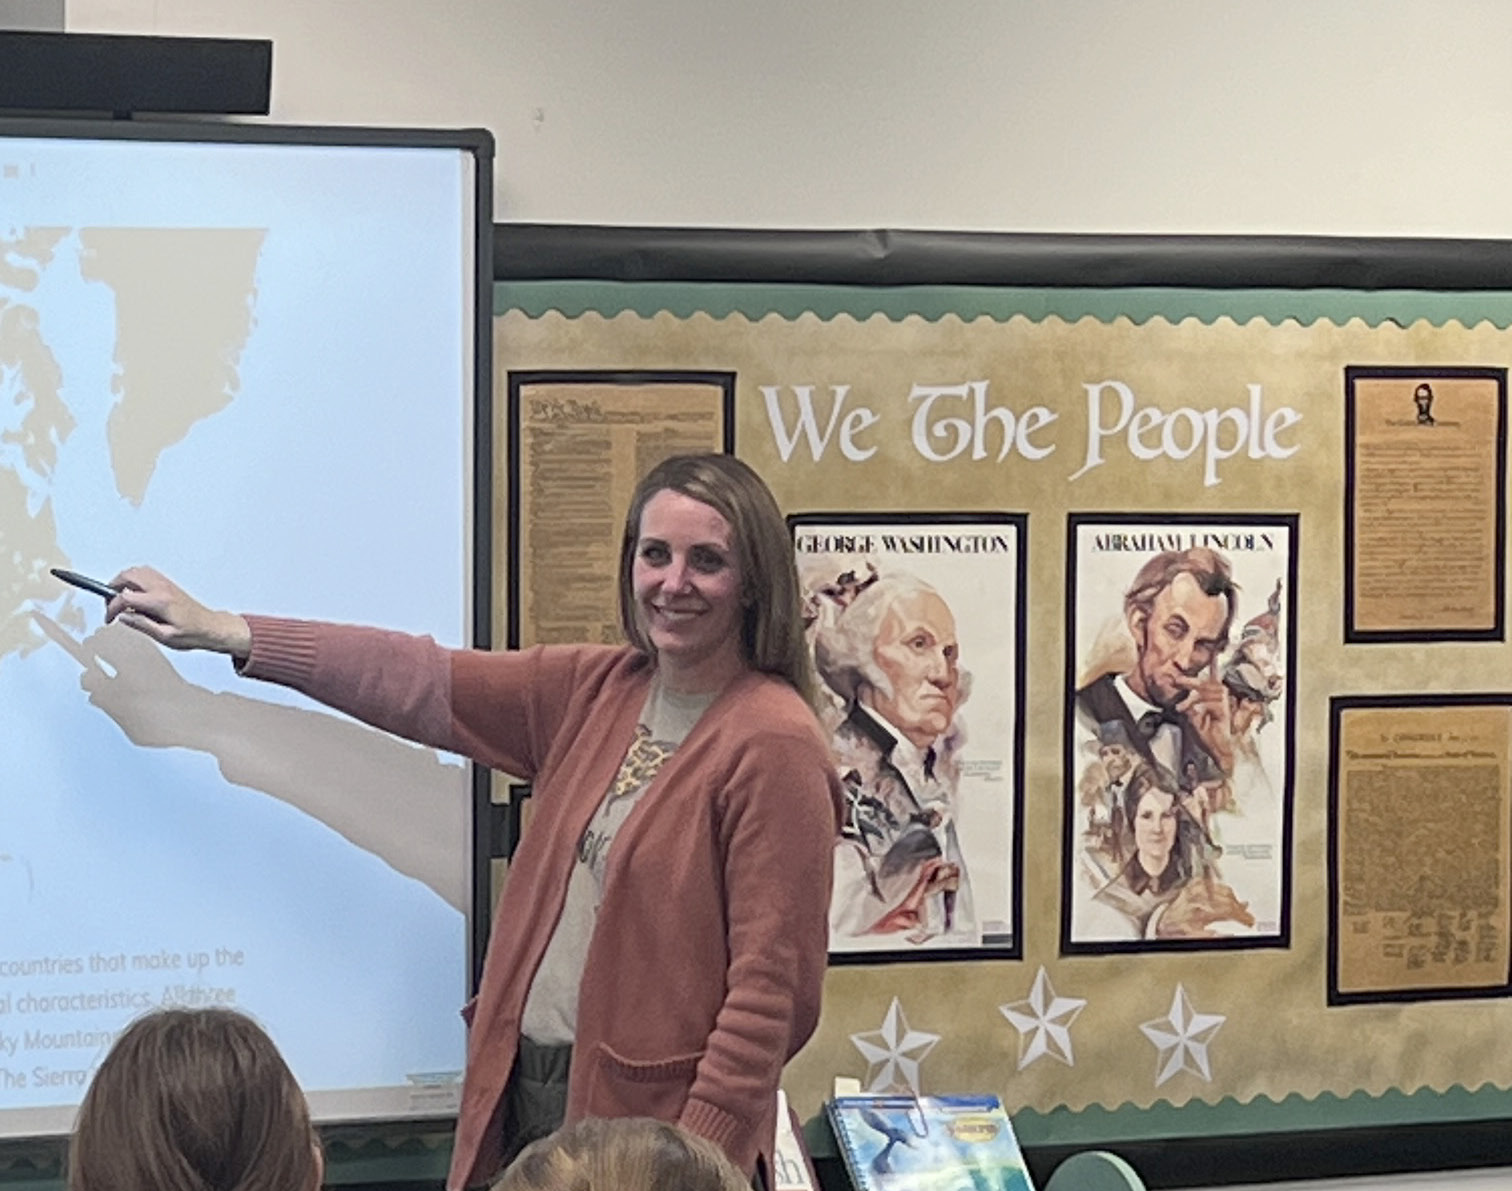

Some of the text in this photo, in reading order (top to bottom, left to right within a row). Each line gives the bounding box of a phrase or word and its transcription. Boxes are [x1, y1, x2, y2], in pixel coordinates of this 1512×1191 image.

[759, 379, 1304, 488] We The People
[797, 534, 1010, 553] GEORGE WASHINGTON
[1092, 533, 1182, 551] ABRAHAM
[88, 952, 127, 975] that
[131, 948, 181, 969] make
[186, 951, 210, 974] up
[215, 947, 245, 967] the
[16, 988, 153, 1014] characteristics.
[32, 1065, 88, 1088] Sierra
